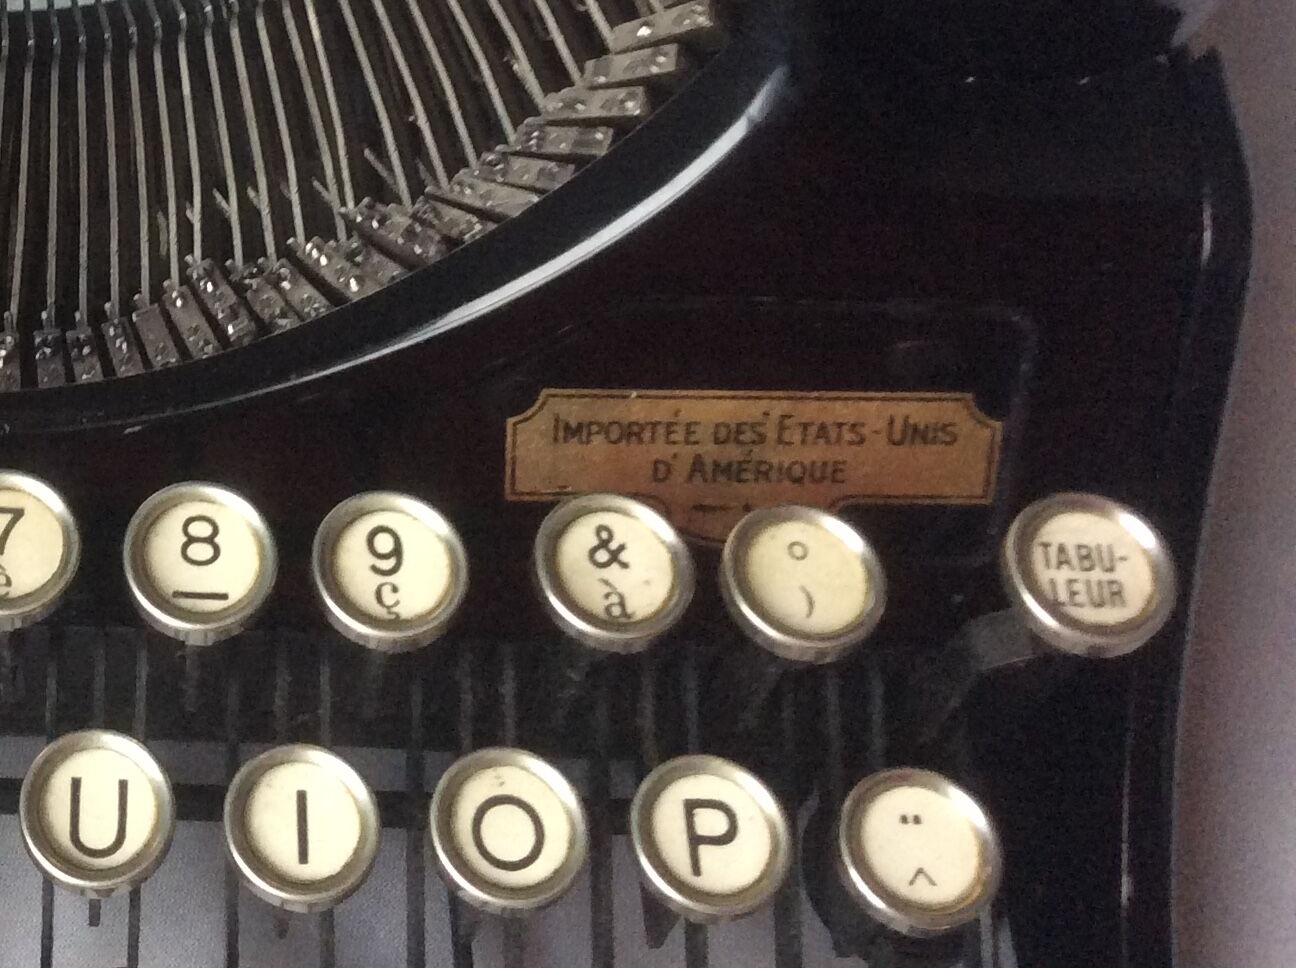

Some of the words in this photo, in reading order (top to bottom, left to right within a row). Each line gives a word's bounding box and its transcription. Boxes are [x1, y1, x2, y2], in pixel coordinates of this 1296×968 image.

[714, 420, 767, 446] DES
[180, 514, 221, 567] 8
[366, 525, 403, 577] 9
[587, 524, 630, 570] &
[1037, 541, 1129, 574] TABU-
[1047, 577, 1127, 609] LEUR
[69, 776, 129, 859] U
[296, 789, 309, 865] I
[473, 794, 545, 872] O
[685, 798, 740, 878] P
